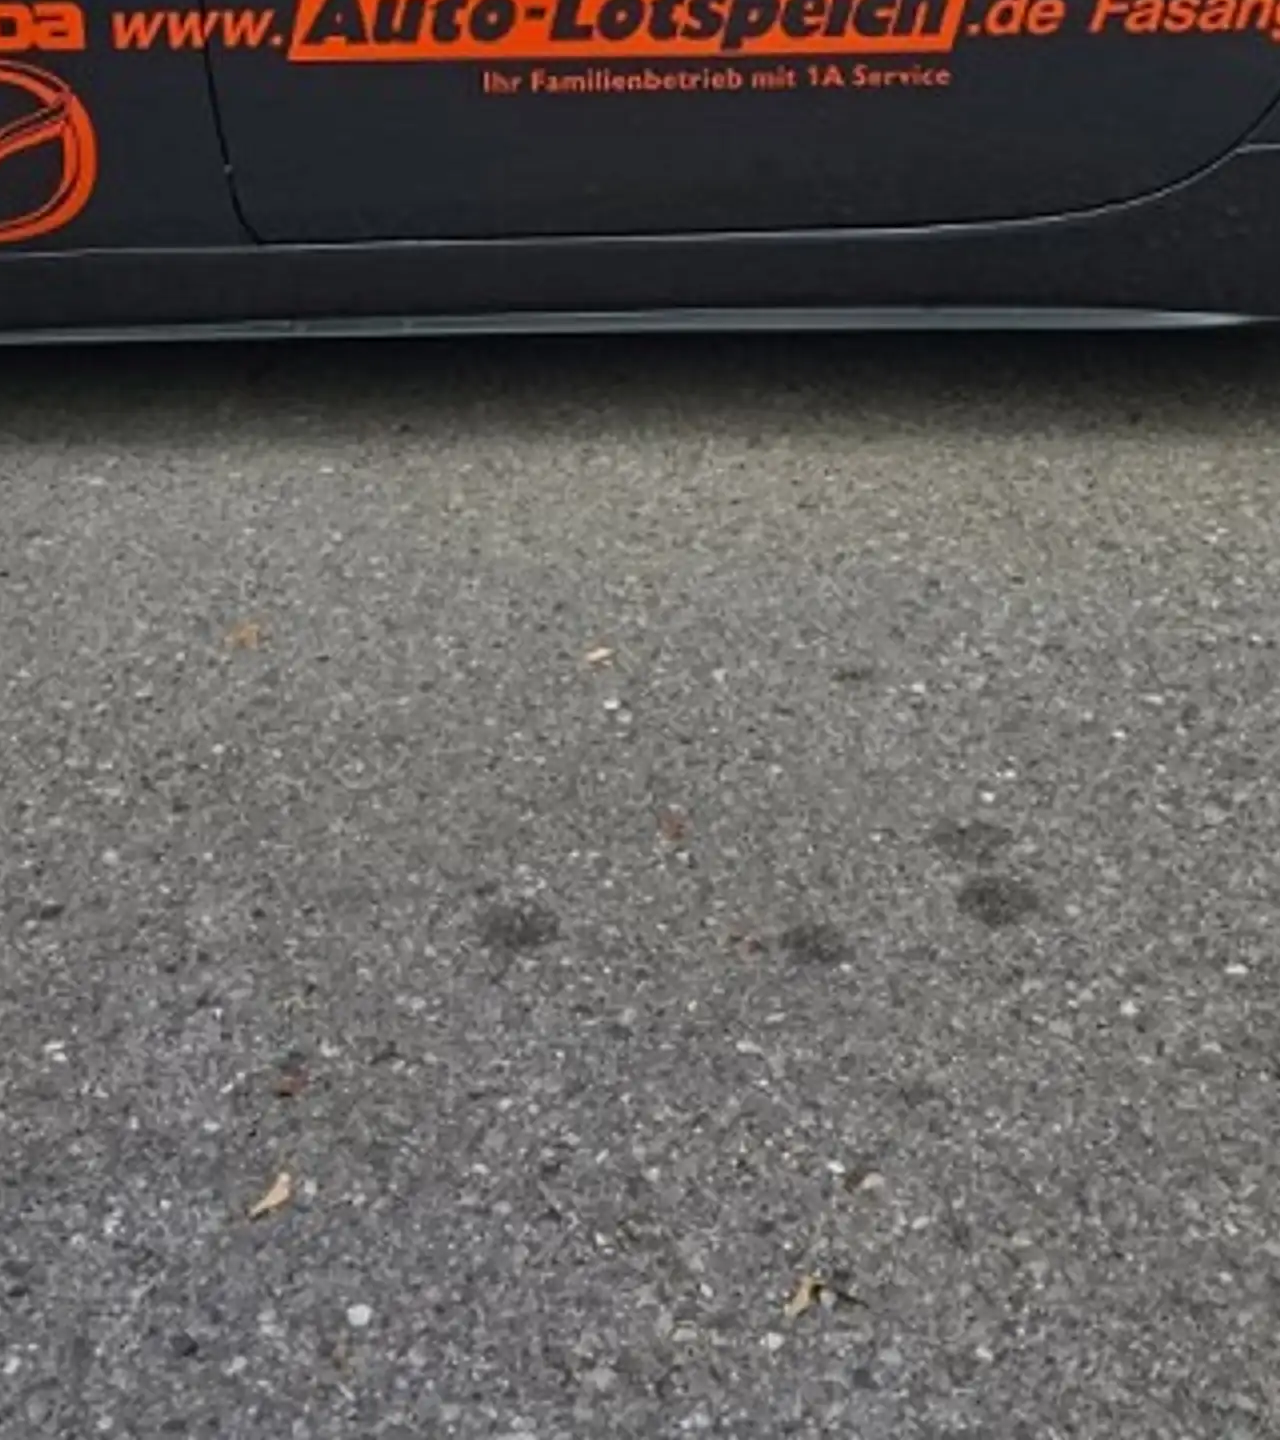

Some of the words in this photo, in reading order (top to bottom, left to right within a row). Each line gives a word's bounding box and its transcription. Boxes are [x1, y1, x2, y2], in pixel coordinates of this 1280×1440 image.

[482, 70, 523, 93] Ihr
[530, 67, 744, 93] Familienbetrieb
[750, 66, 797, 88] mit
[808, 64, 844, 86] 1A
[851, 63, 952, 87] Service
